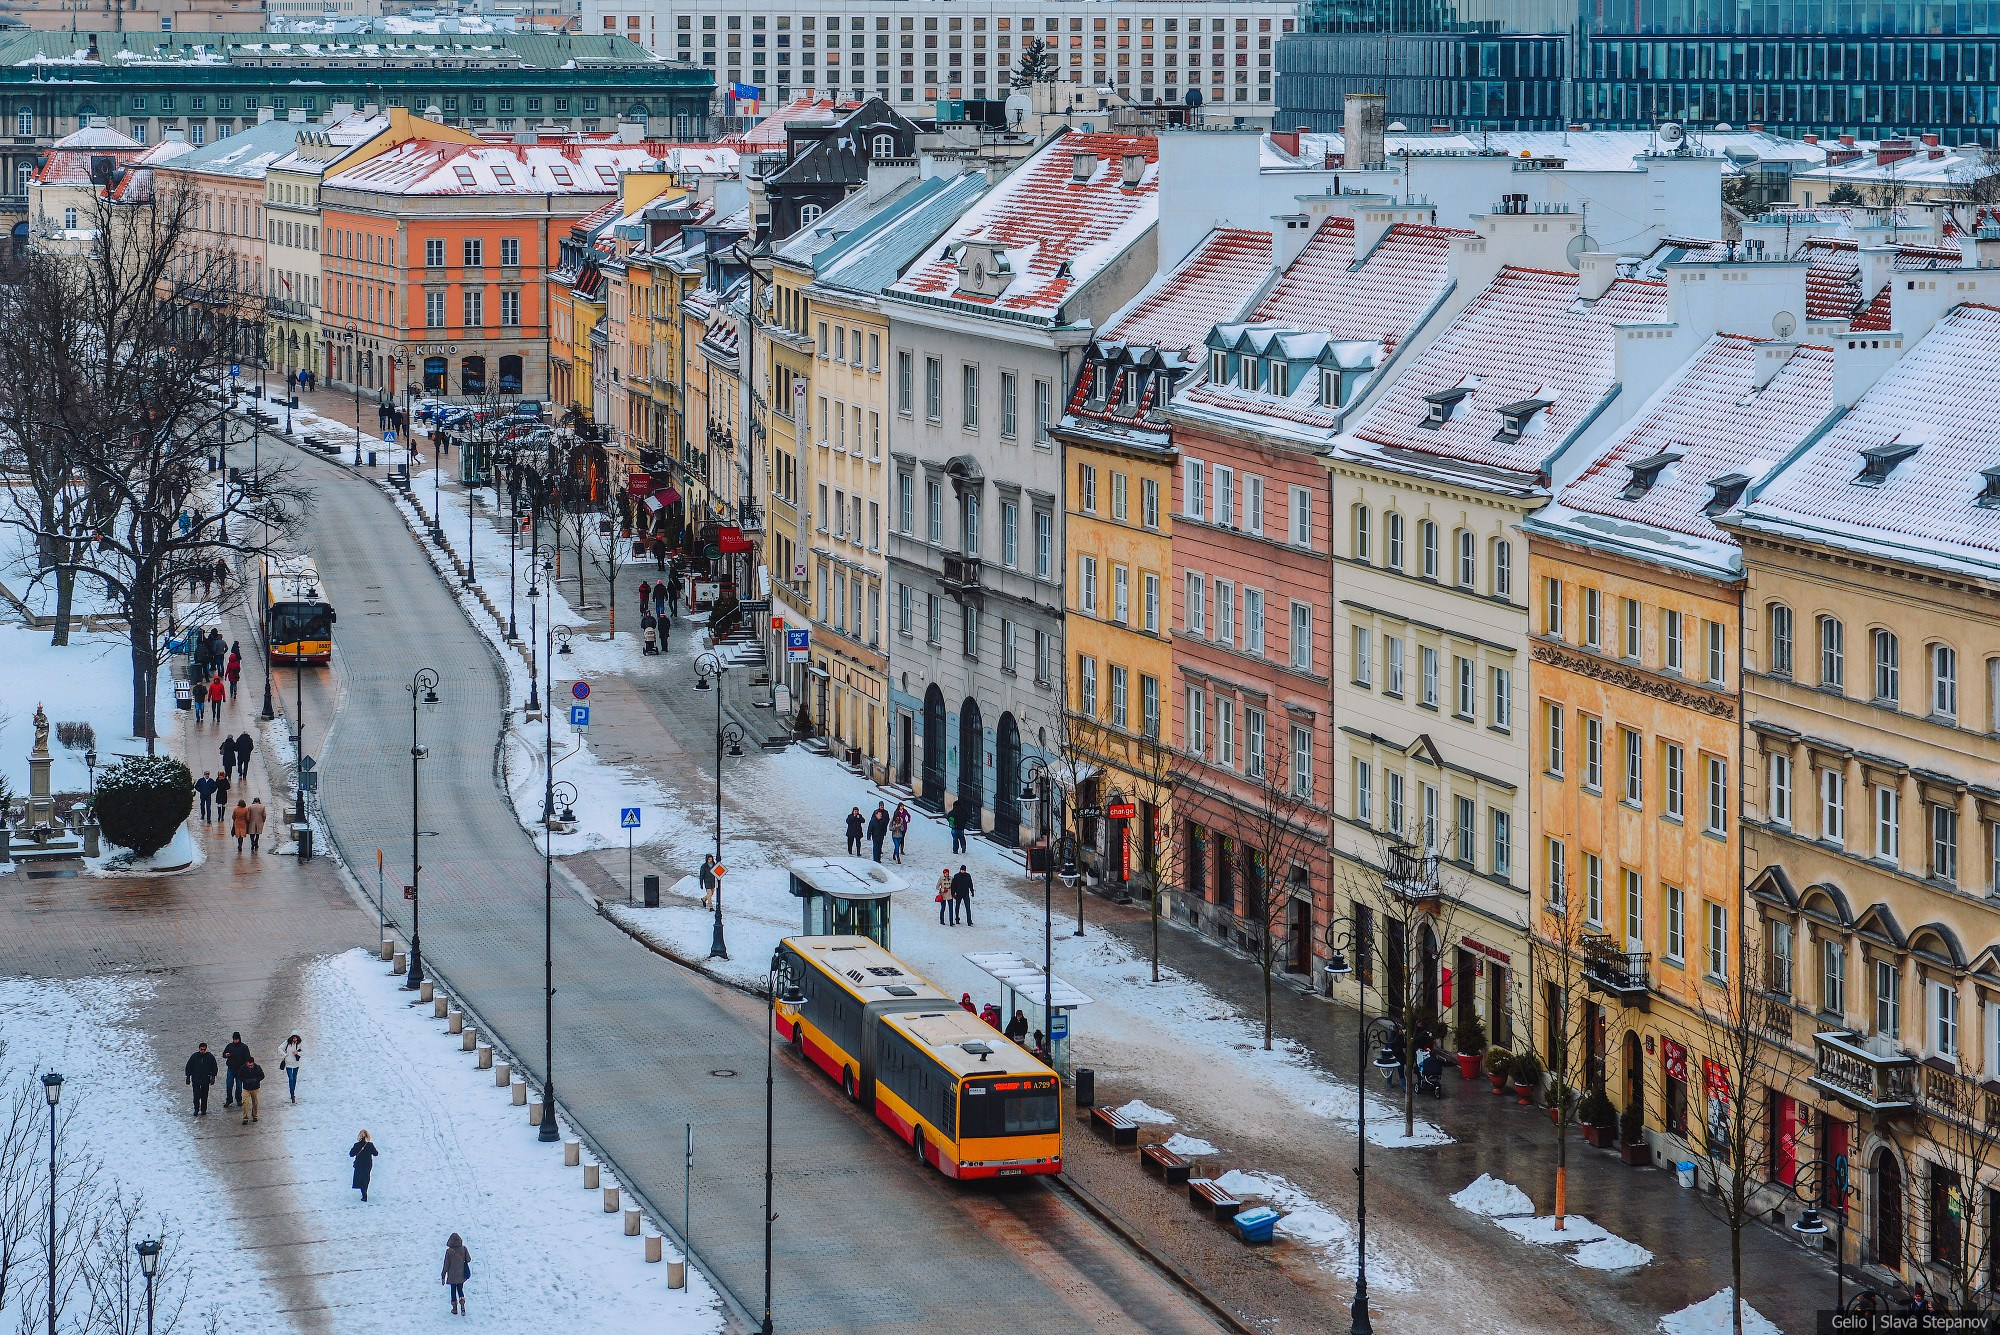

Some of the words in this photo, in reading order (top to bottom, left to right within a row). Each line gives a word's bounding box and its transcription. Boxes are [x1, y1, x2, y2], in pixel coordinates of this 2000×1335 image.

[416, 345, 458, 355] KINO
[575, 709, 586, 722] P
[1109, 807, 1134, 815] change
